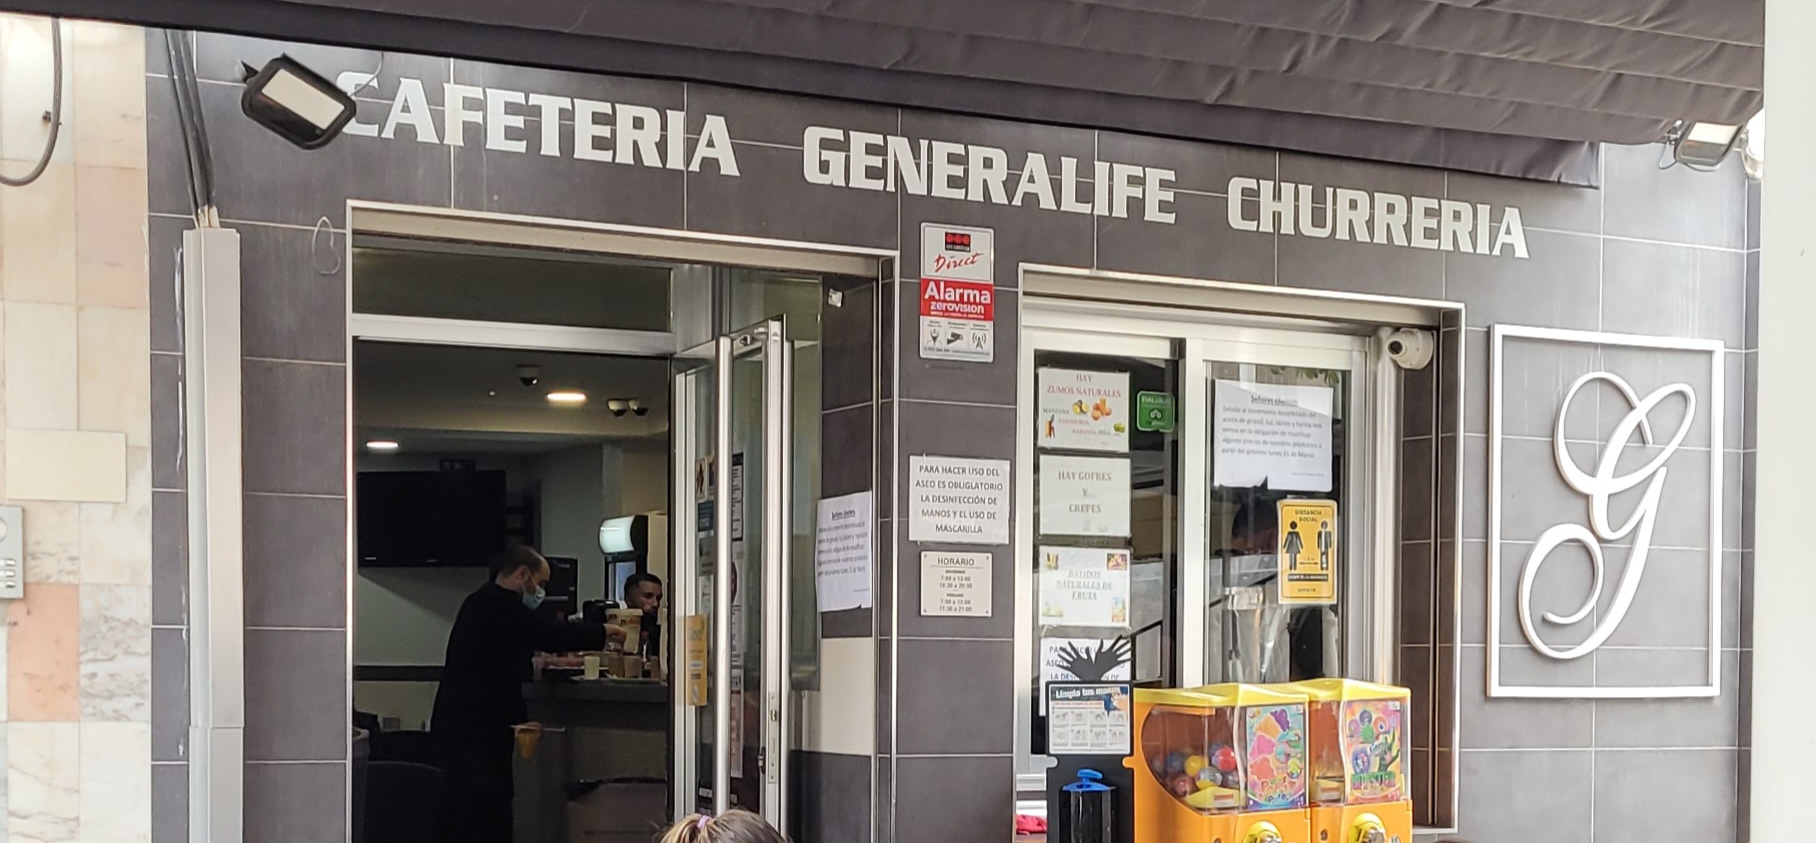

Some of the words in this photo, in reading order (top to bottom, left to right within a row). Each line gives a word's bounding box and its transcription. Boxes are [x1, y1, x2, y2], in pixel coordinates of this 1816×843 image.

[336, 71, 741, 176] CAFETERIA
[802, 126, 1177, 224] GENERALIFE
[1228, 177, 1529, 258] CHURRERIA
[934, 252, 984, 273] Direct
[924, 281, 991, 304] Alarma
[930, 301, 984, 314] zerovision
[1077, 374, 1093, 382] HAY
[1047, 385, 1075, 394] ZUMOS
[1075, 388, 1121, 397] NATURALES
[1251, 395, 1273, 404] Señores
[920, 465, 939, 473] PARA
[942, 466, 966, 474] HACER
[969, 467, 984, 475] USO
[986, 468, 999, 476] DEL
[1058, 471, 1078, 480] HAY
[1079, 472, 1111, 481] GOFRES
[915, 480, 935, 488] ASEO
[1082, 488, 1088, 497] Y
[932, 494, 985, 505] DESINFECCIÓN
[988, 497, 997, 505] DE
[1069, 504, 1101, 513] CREPES
[922, 509, 950, 518] MANOS
[953, 510, 957, 518] Y
[969, 511, 984, 519] USO
[936, 525, 982, 533] MASCARILLA
[938, 557, 974, 566] HORARIO
[1068, 570, 1101, 578] BATIDOS
[1057, 580, 1101, 589] NATURALES
[1102, 581, 1112, 589] DE
[1072, 591, 1097, 600] FRUTA
[1056, 689, 1080, 699] Limpia
[1082, 688, 1094, 696] tus
